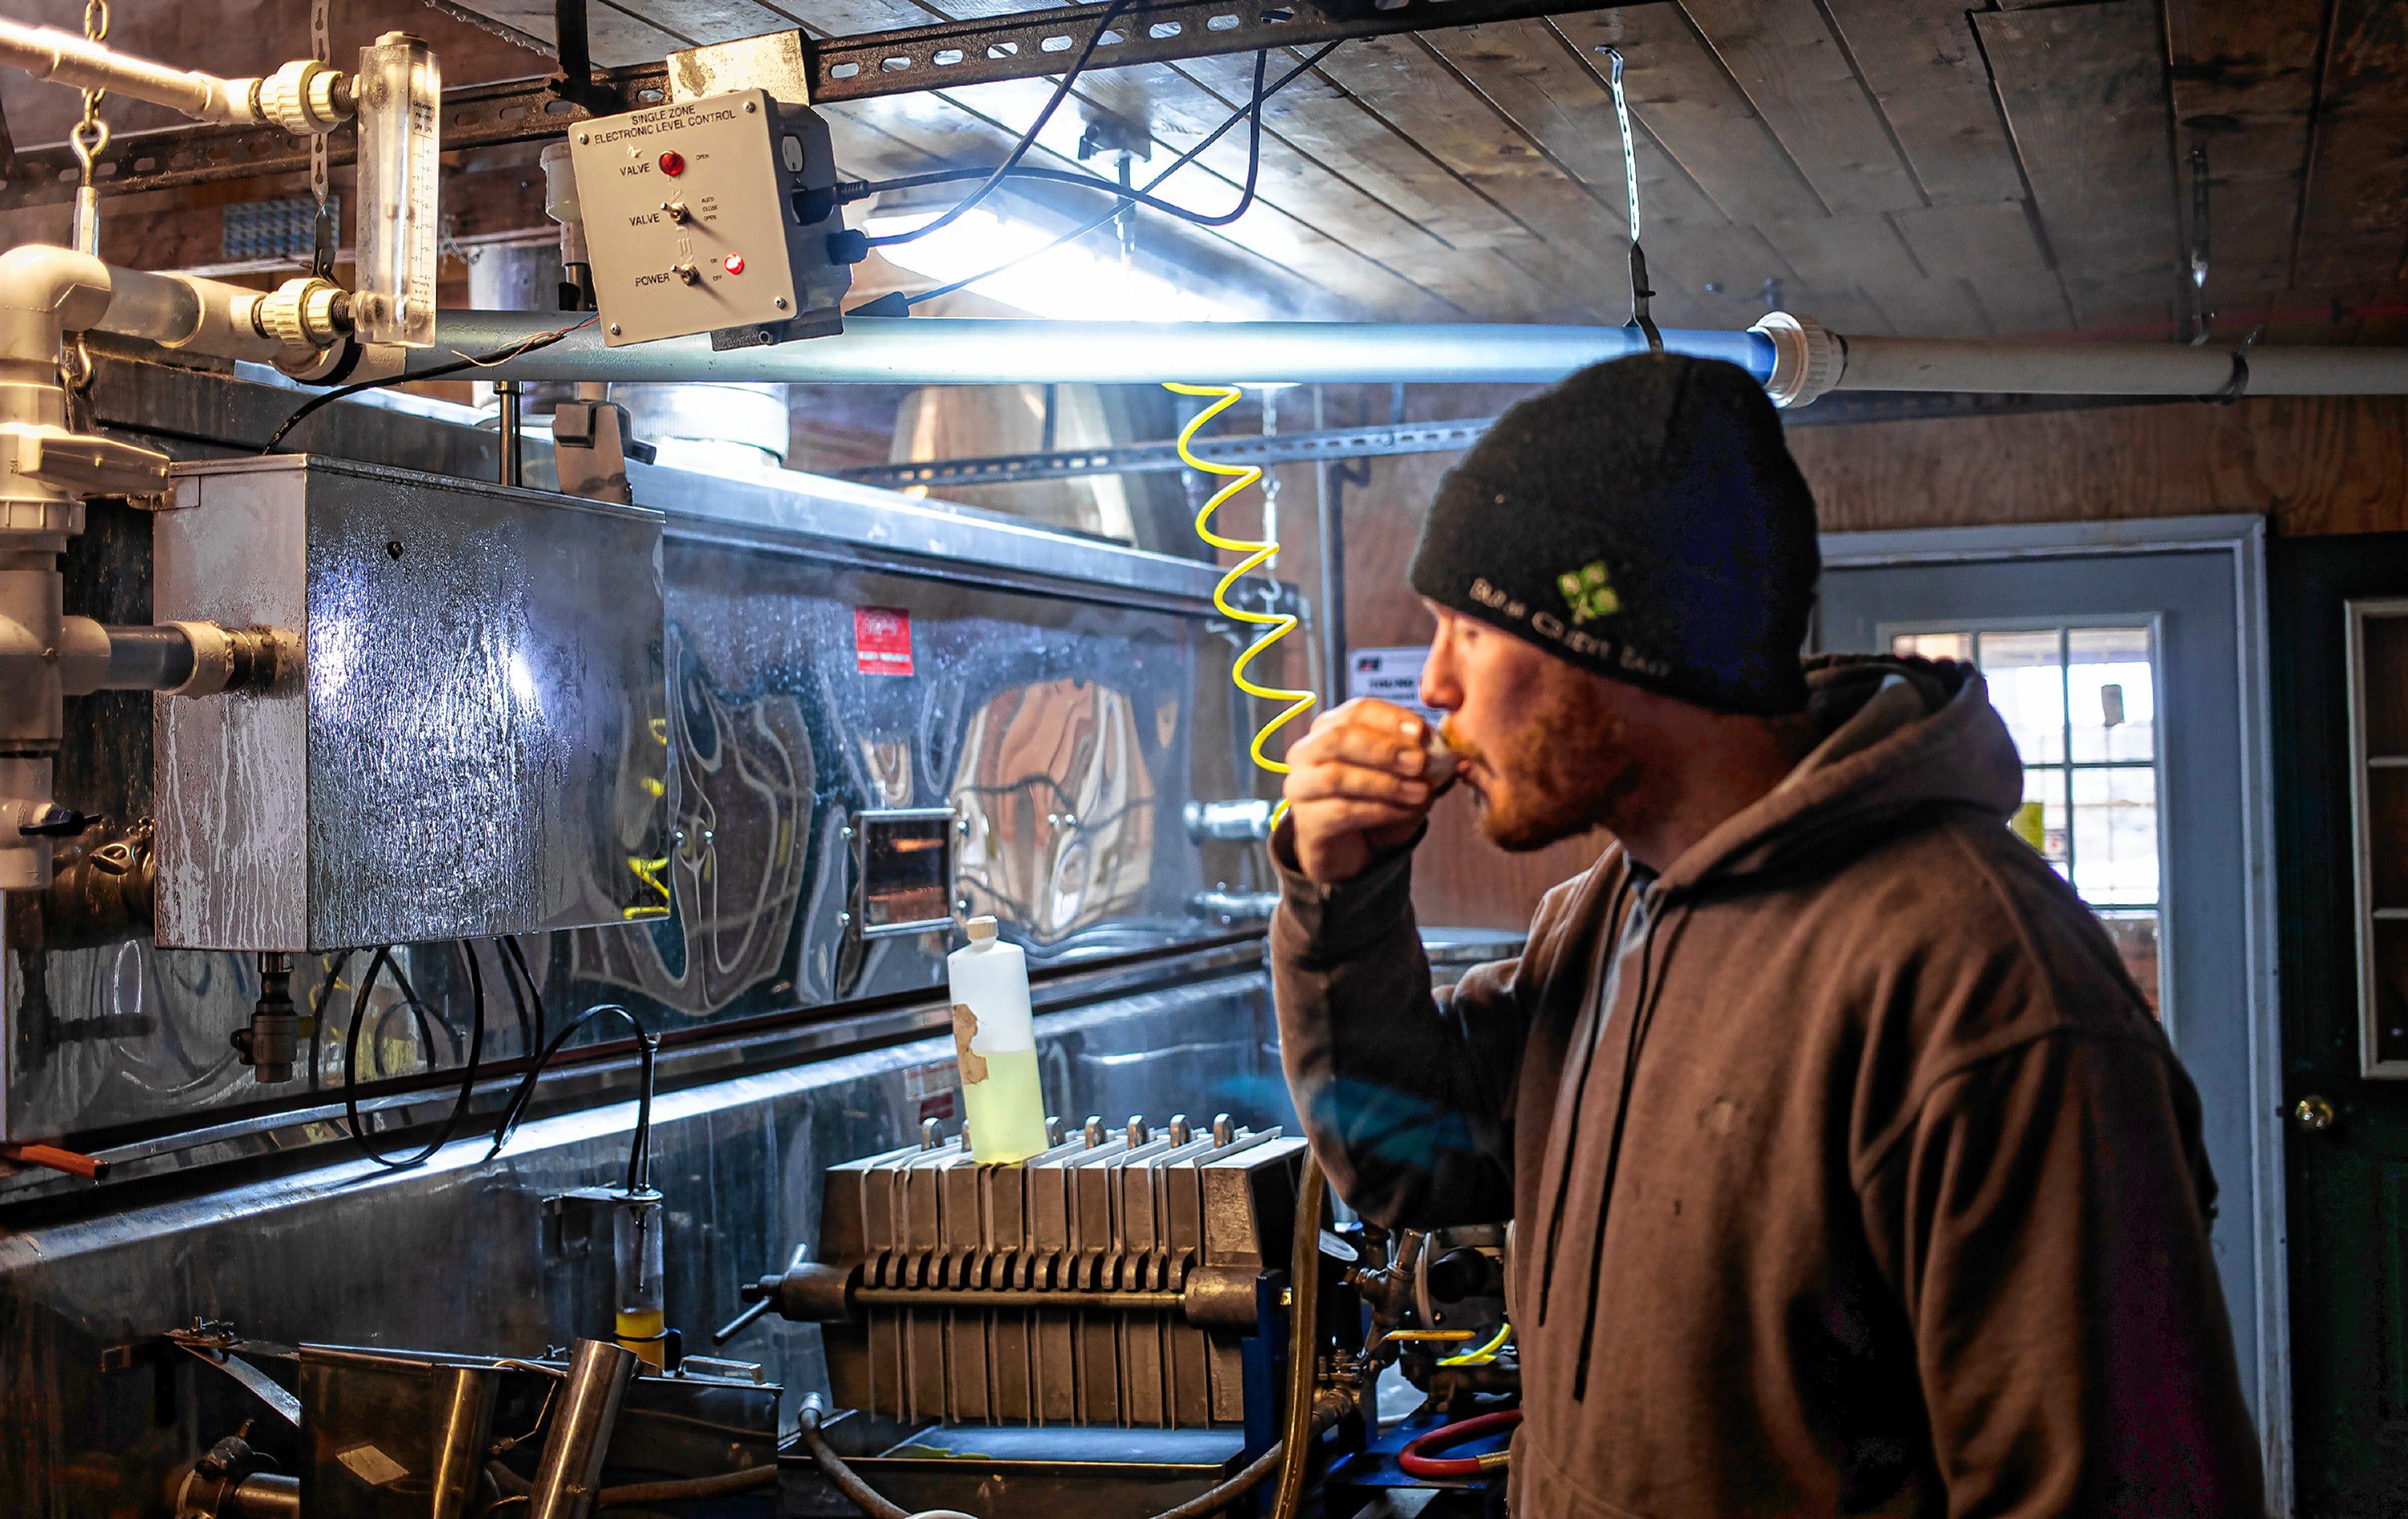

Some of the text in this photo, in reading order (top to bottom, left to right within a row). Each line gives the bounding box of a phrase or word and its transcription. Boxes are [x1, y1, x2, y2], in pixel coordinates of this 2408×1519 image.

[632, 104, 696, 125] SINGLE ZONE
[594, 109, 737, 144] ELECTRONIC LEVEL CONTROL
[695, 153, 710, 161] OPEN
[619, 162, 651, 177] VALVE
[701, 196, 715, 204] AUTO
[628, 213, 661, 227] VALVE
[635, 272, 670, 287] POWER
